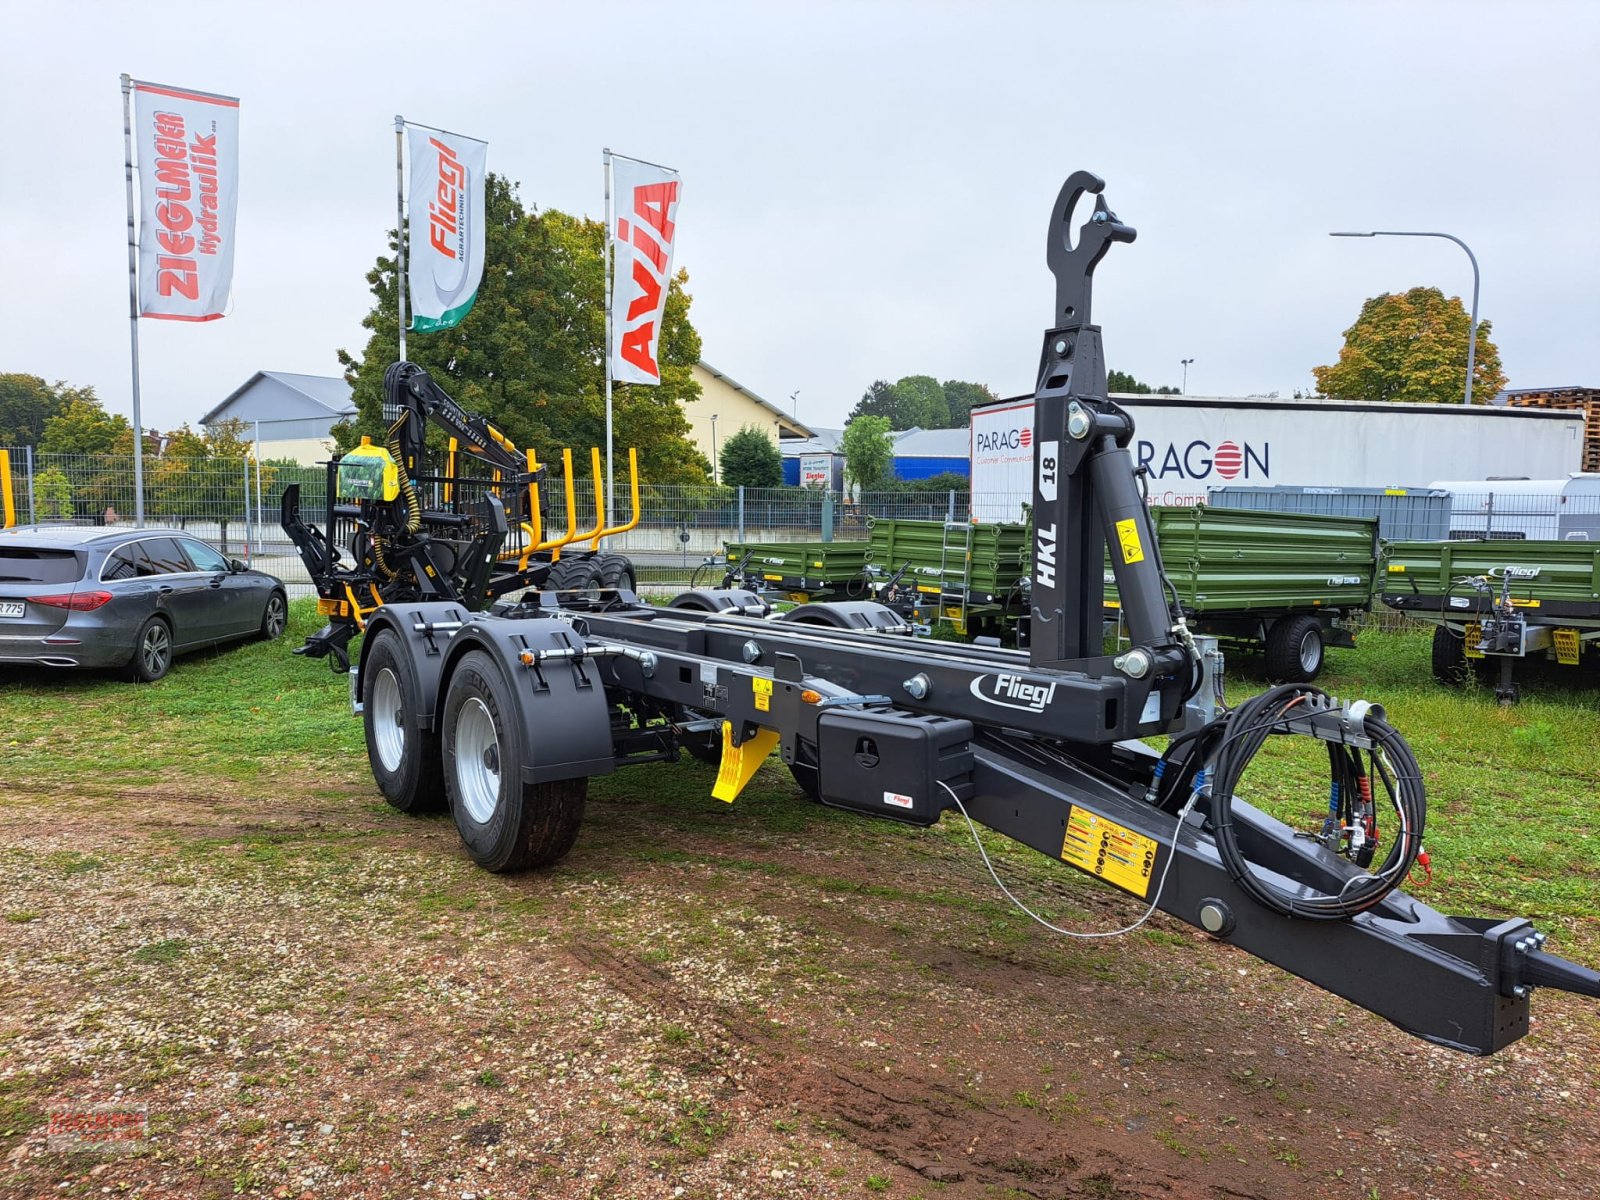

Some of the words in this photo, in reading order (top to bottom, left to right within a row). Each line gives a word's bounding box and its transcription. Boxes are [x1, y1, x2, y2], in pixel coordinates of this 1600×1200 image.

[153, 111, 200, 301] ZIEGLMEIER
[190, 132, 221, 255] Hydraulik
[429, 136, 464, 259] Fliegl
[977, 427, 1032, 452] PARAGO
[1043, 457, 1056, 485] 18
[1138, 440, 1269, 479] RAGON
[1036, 523, 1057, 589] HKL
[6, 603, 23, 614] 775
[994, 673, 1056, 708] Fliegl
